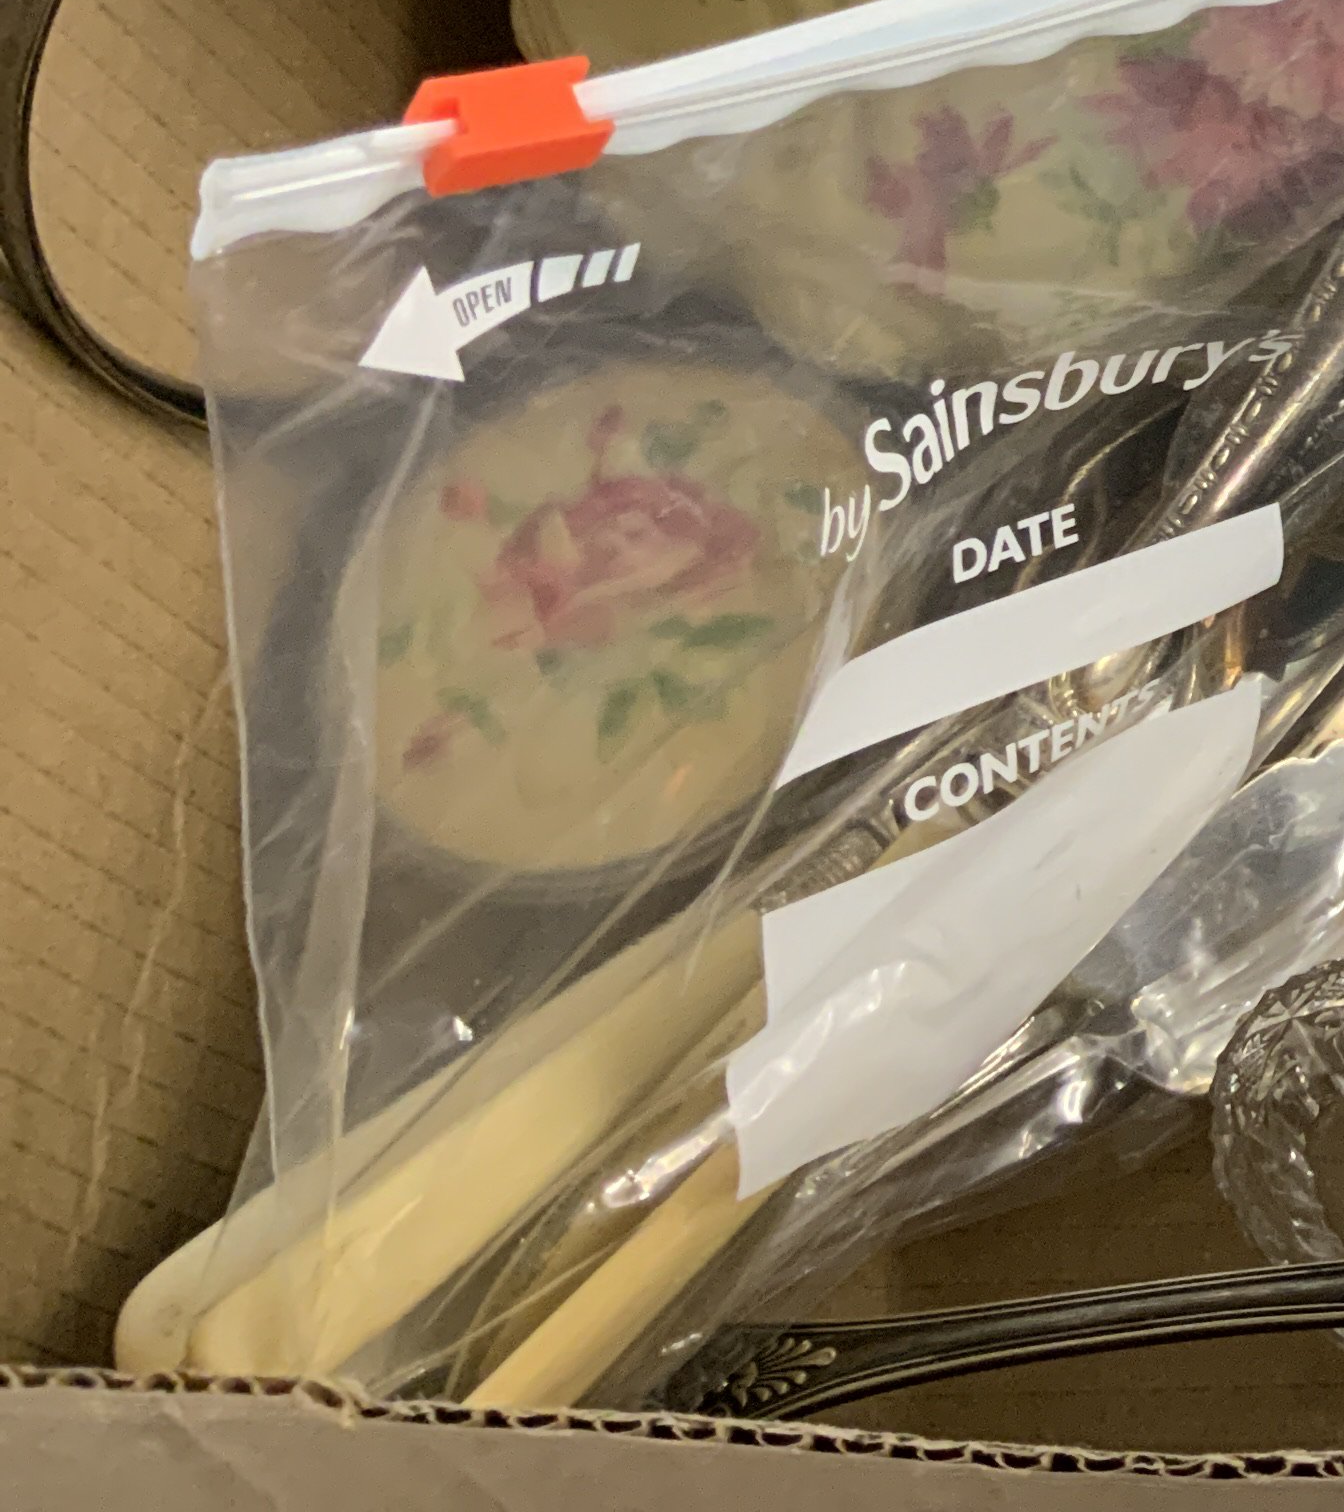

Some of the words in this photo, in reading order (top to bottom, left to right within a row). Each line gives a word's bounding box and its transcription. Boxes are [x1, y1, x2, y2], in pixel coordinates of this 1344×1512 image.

[452, 276, 513, 328] OPEN
[820, 483, 871, 562] by
[864, 329, 1303, 512] Sainsbury's
[952, 503, 1080, 584] DATE
[904, 677, 1163, 822] CONTENTS
